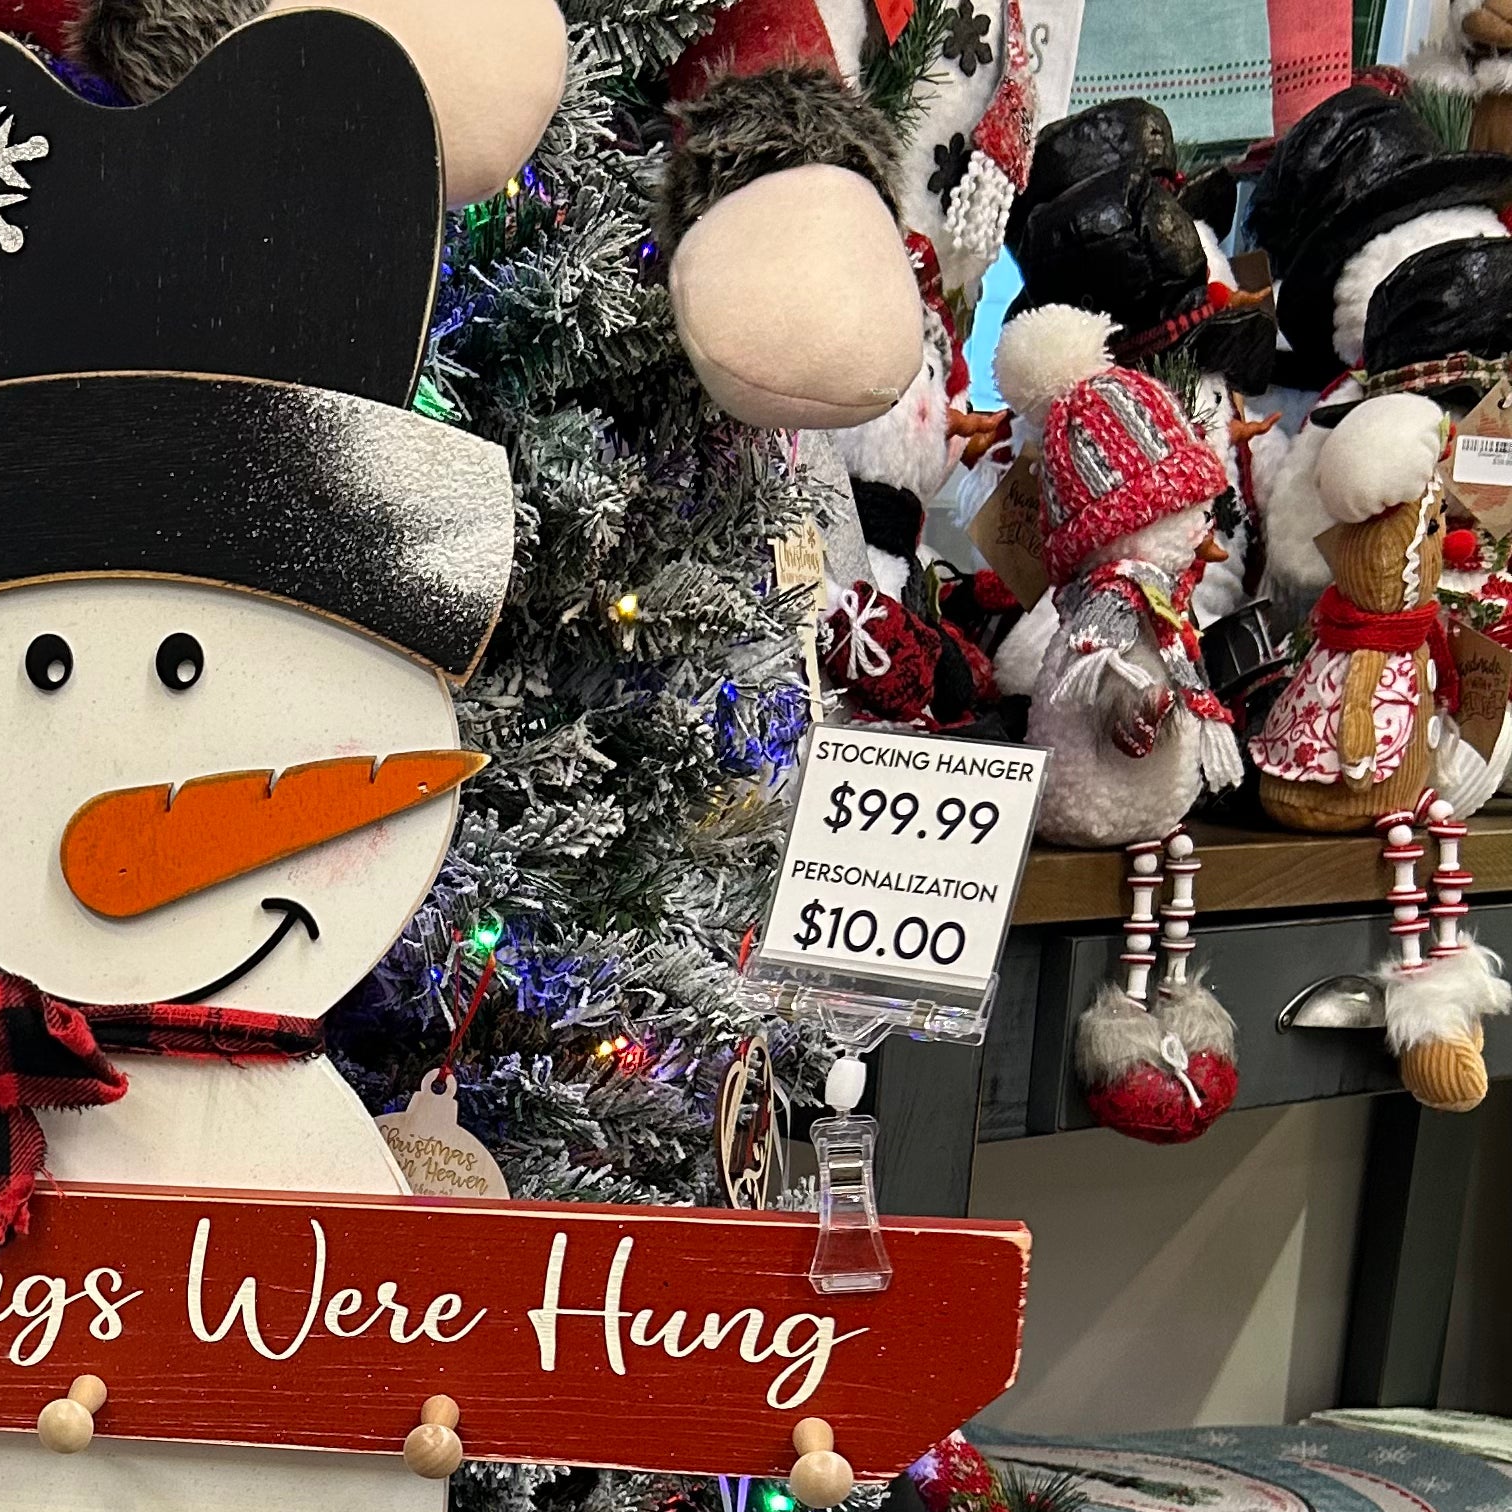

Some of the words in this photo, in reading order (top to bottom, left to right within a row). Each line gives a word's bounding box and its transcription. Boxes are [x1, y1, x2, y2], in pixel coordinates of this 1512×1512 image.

[816, 741, 930, 771] STOCKING
[935, 753, 1034, 782] HANGER
[823, 780, 1000, 845] $99.99
[791, 859, 999, 904] PERSONALIZATION
[793, 898, 966, 966] $10.00
[422, 1157, 488, 1196] Heaven
[188, 1217, 488, 1361] Were
[528, 1231, 871, 1410] Hung
